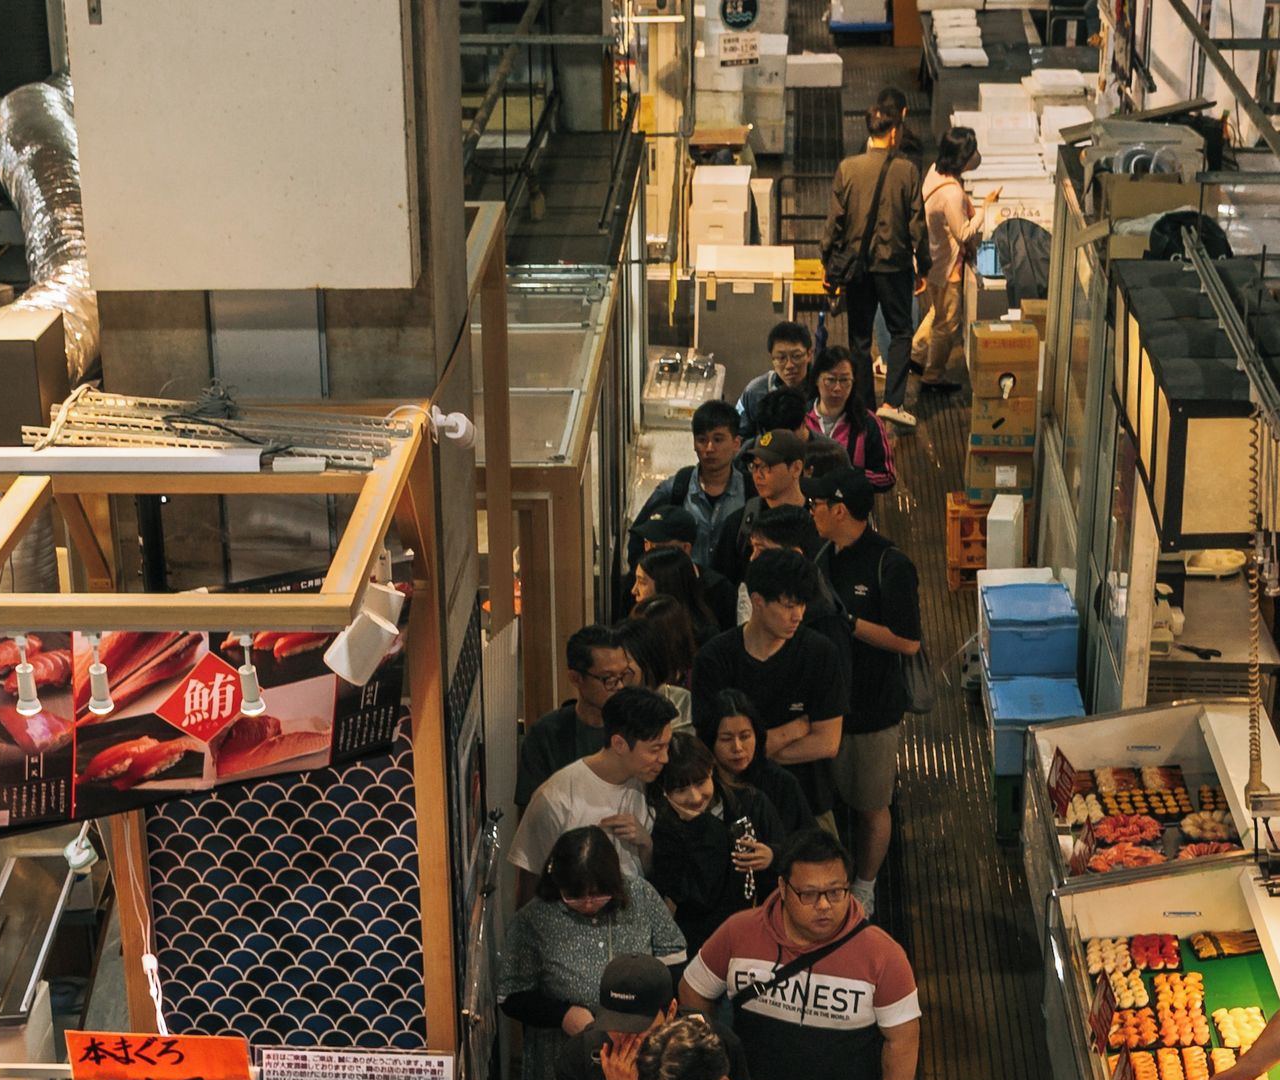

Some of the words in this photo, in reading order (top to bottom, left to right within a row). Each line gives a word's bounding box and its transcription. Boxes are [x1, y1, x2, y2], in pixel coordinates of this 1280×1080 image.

[181, 672, 236, 728] 鮪
[735, 971, 866, 1013] ERNEST
[79, 1036, 185, 1066] 本まぐろ
